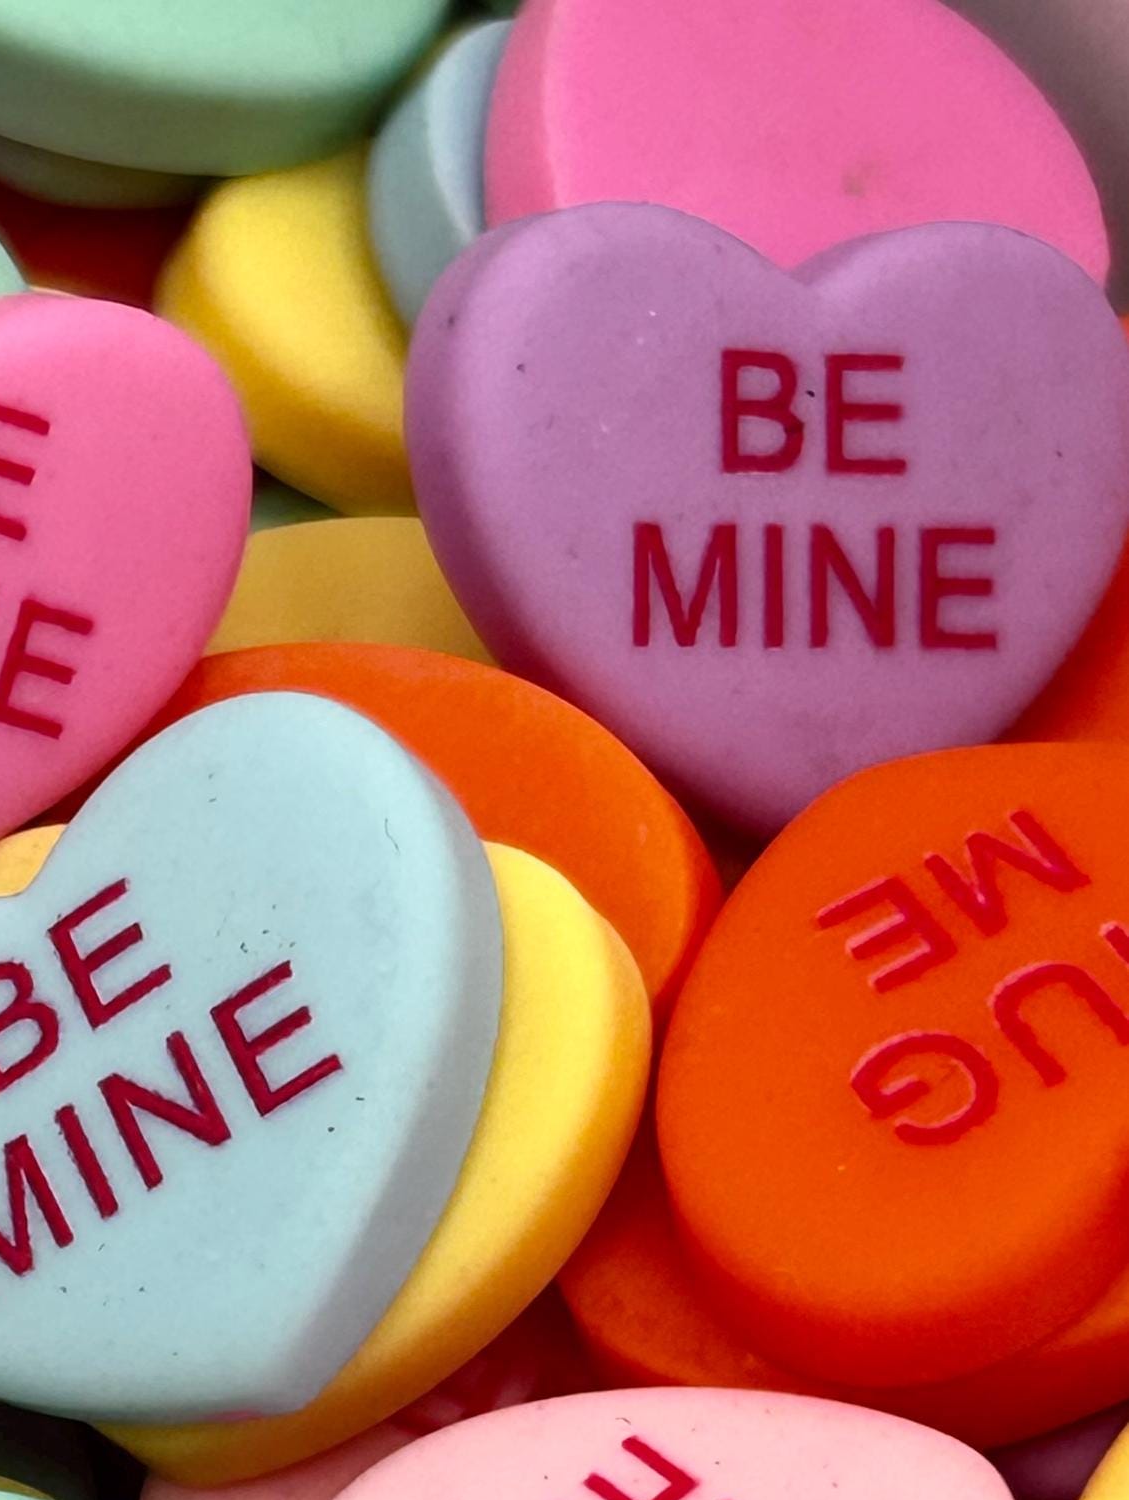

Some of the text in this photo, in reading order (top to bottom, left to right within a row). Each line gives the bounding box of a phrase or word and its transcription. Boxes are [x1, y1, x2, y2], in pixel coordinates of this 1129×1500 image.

[720, 348, 906, 475] BE
[632, 521, 998, 650] MINE
[815, 810, 1091, 994] ME
[849, 921, 1129, 1146] UG
